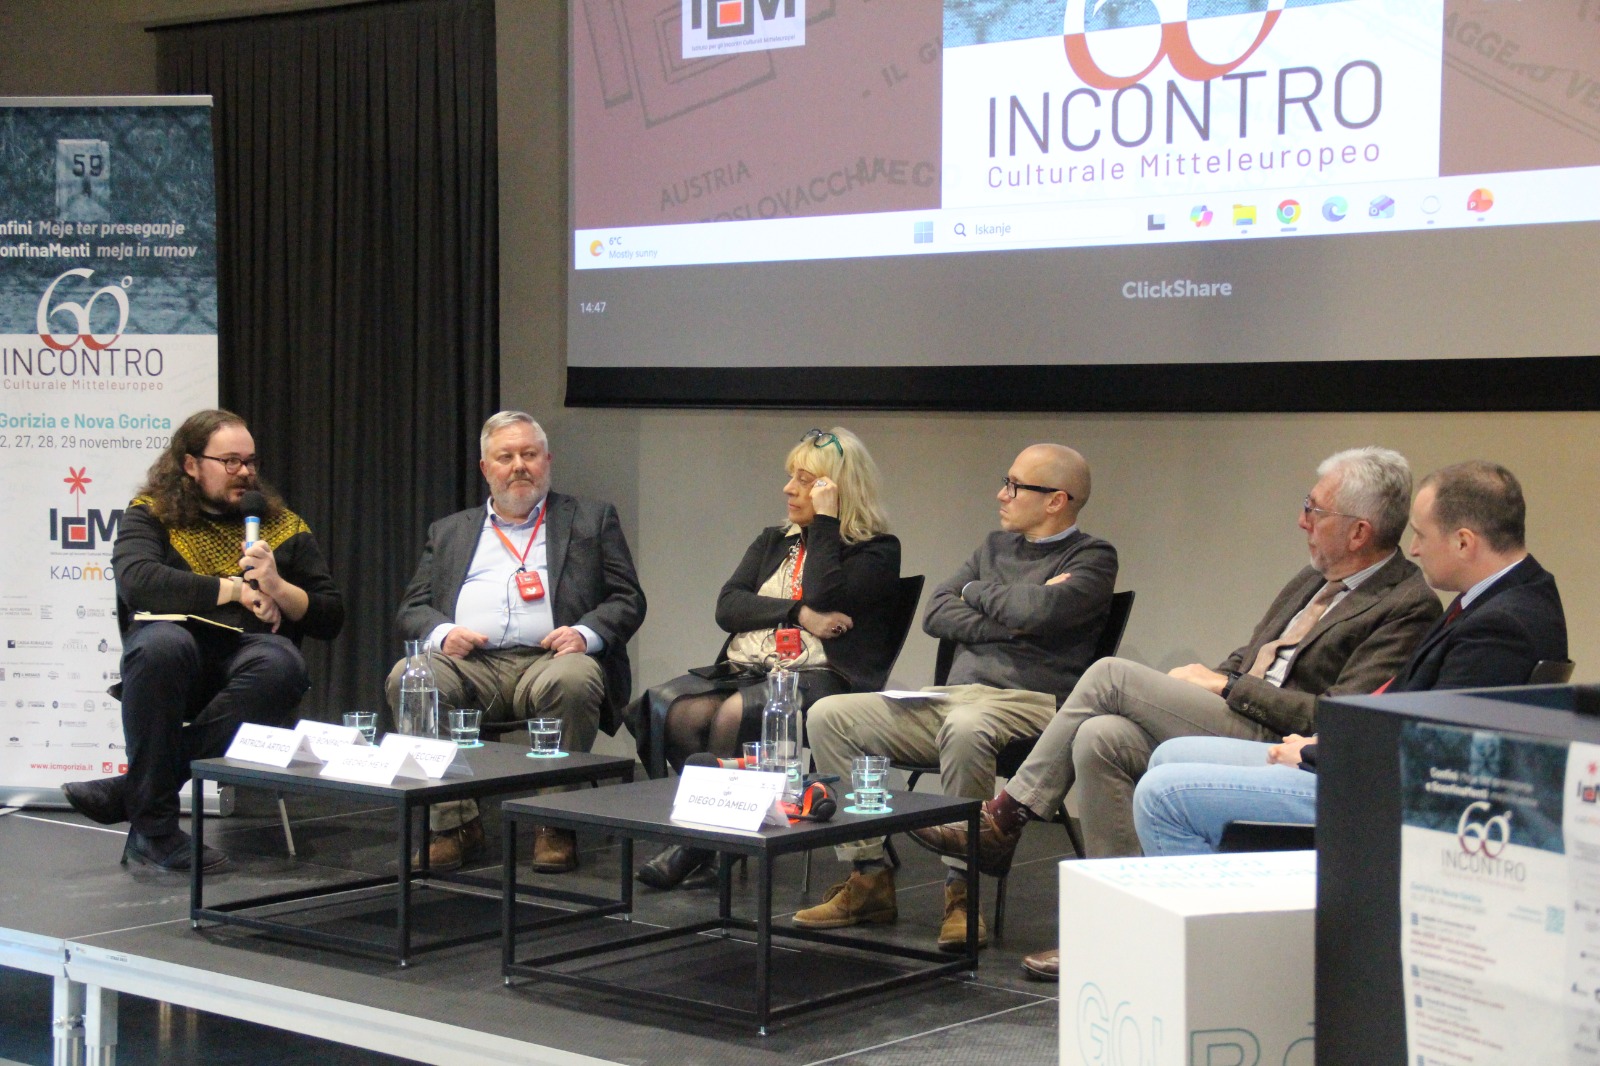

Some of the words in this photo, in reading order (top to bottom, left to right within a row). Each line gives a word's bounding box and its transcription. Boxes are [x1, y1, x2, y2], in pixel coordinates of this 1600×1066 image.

[988, 59, 1383, 158] INCONTRO
[72, 153, 104, 177] 59
[988, 159, 1126, 189] Culturale
[1140, 142, 1382, 178] Mitteleuropeo
[660, 159, 750, 211] AUSTRIA
[39, 221, 73, 237] Meje
[77, 222, 99, 235] ter
[101, 221, 185, 238] preseganje
[975, 221, 1011, 238] Iskanje
[97, 244, 133, 260] meja
[136, 244, 150, 257] in
[153, 246, 198, 258] umov
[609, 249, 633, 260] Mostly
[635, 249, 658, 258] sunny
[1122, 279, 1233, 299] ClickShare
[580, 301, 607, 314] 14:47
[3, 348, 164, 376] INCONTRO
[4, 378, 67, 390] Culturale
[72, 379, 164, 391] Mitteleuropeo
[0, 413, 56, 429] Gorizia
[61, 418, 70, 429] e
[74, 414, 115, 429] Nova
[119, 414, 171, 429] Gorica
[61, 436, 76, 448] 29
[79, 437, 143, 449] novembre
[30, 762, 94, 772] www.icmgorizia.it
[688, 794, 716, 806] DIEGO
[717, 798, 758, 812] D'AMELIO
[1441, 849, 1526, 882] INCONTRO
